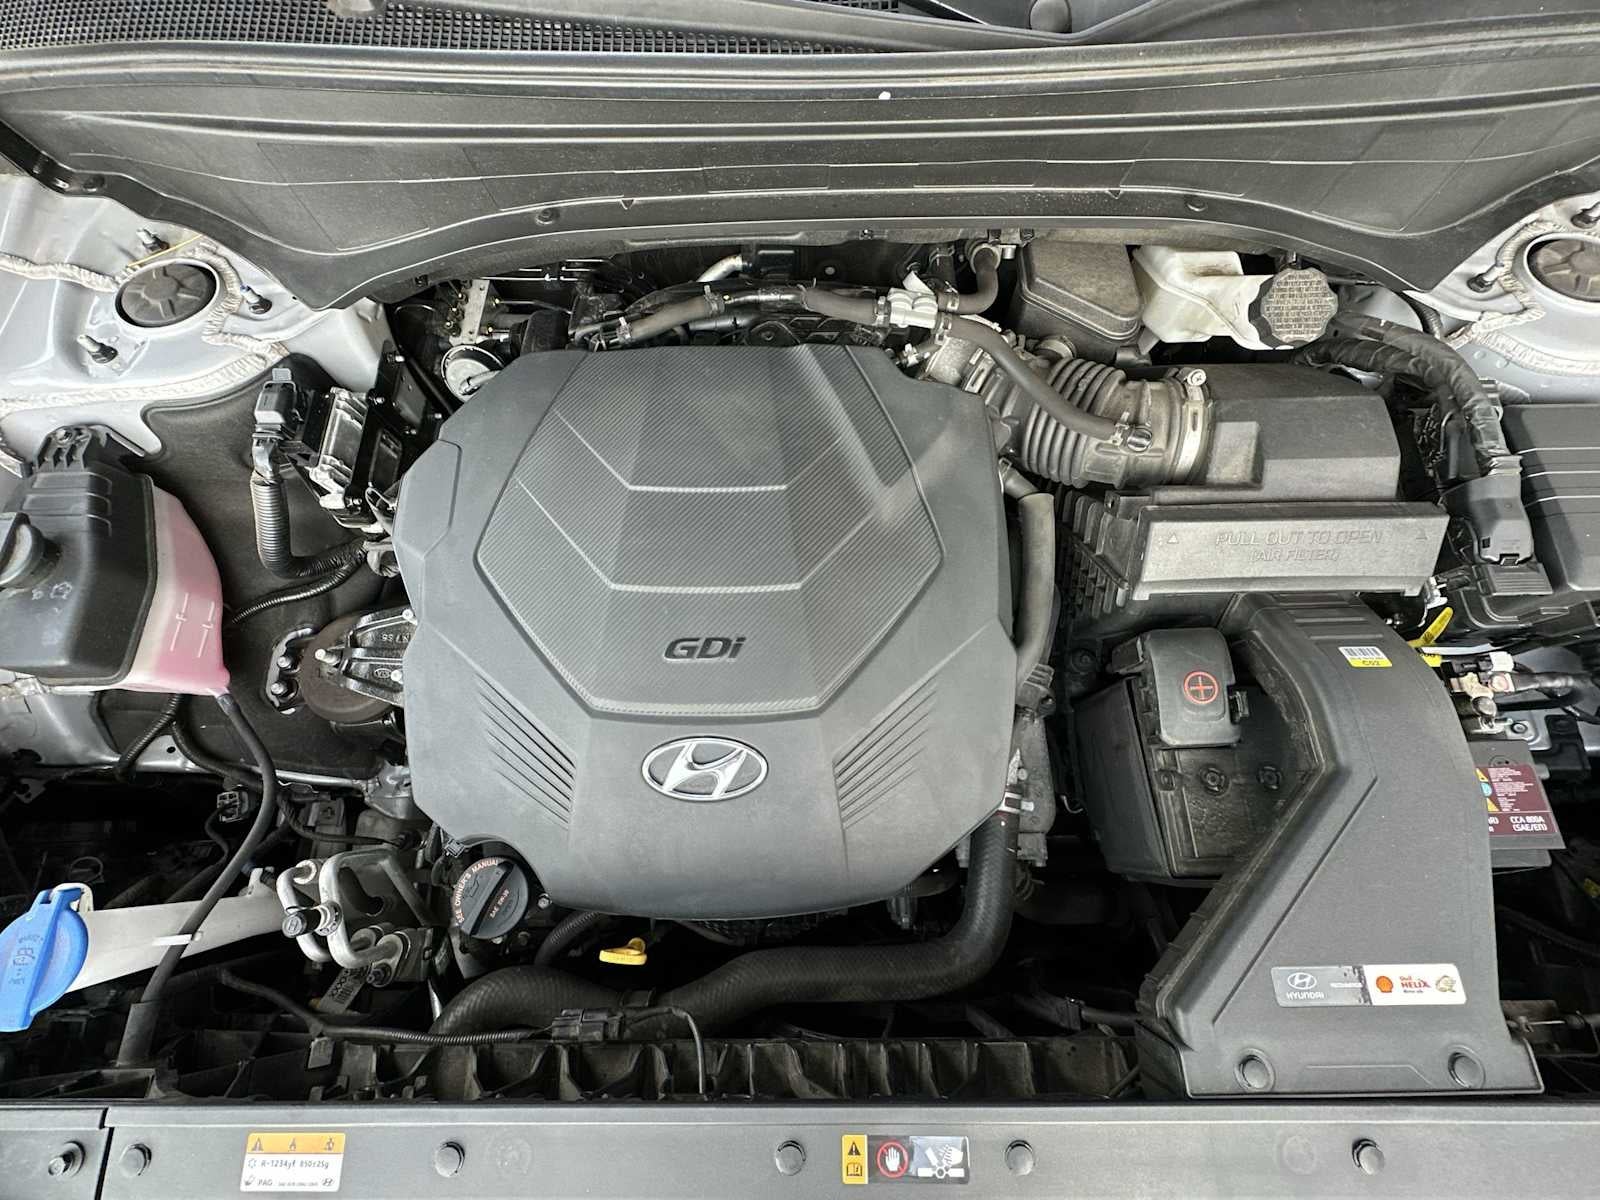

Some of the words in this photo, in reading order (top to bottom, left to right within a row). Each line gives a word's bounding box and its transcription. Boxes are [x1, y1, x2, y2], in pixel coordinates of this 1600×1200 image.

[1215, 532, 1260, 545] PULL
[1265, 532, 1302, 545] OUT
[1308, 531, 1331, 545] TO
[1335, 530, 1384, 544] OPEN
[664, 637, 746, 659] GDi
[1509, 816, 1525, 824] CCA
[455, 872, 471, 906] OWNER'S
[455, 909, 465, 924] SEE
[1401, 979, 1431, 989] HELIX
[1286, 991, 1328, 1001] HYUNDAI
